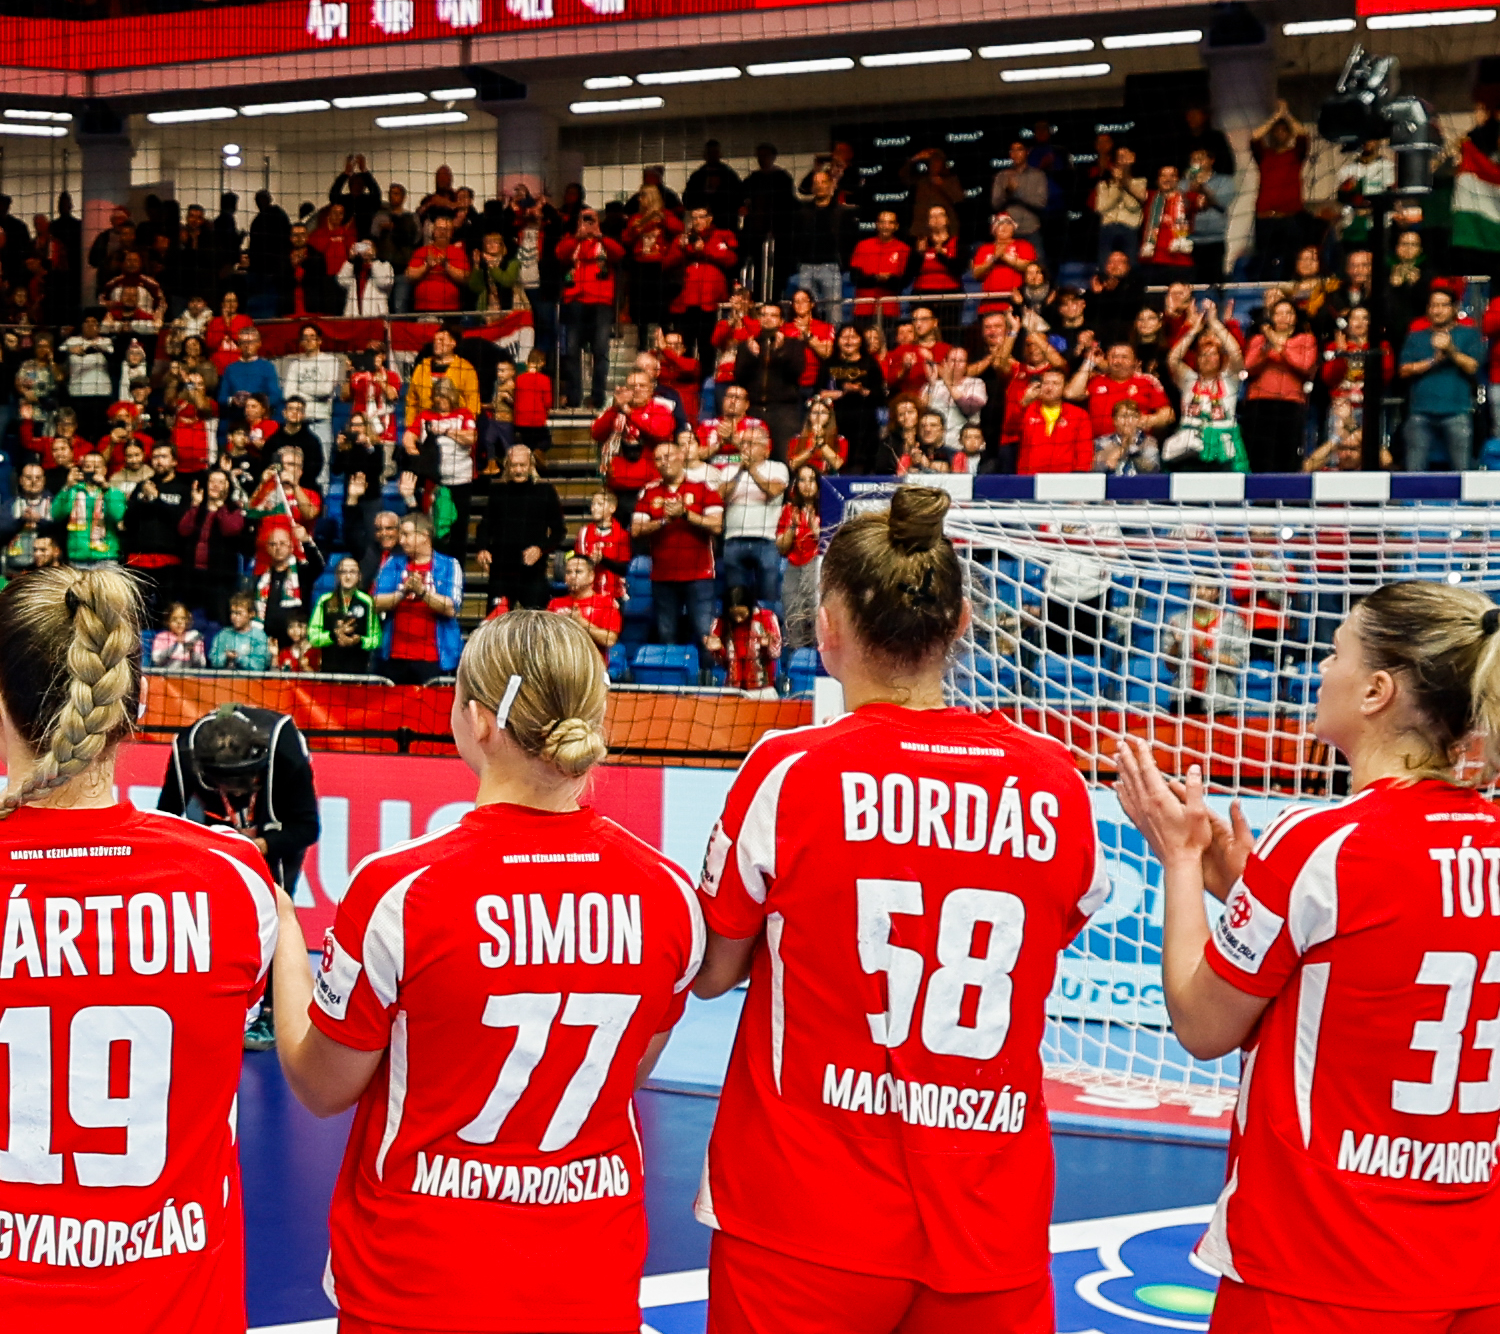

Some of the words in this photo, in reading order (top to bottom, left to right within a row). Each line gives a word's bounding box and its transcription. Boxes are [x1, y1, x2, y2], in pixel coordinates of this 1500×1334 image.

[841, 771, 1059, 863] BORDÁS
[476, 892, 642, 969] SIMON
[856, 878, 1025, 1061] 58
[457, 992, 642, 1153] 77
[823, 1063, 1027, 1135] MAGYARORSZÁG
